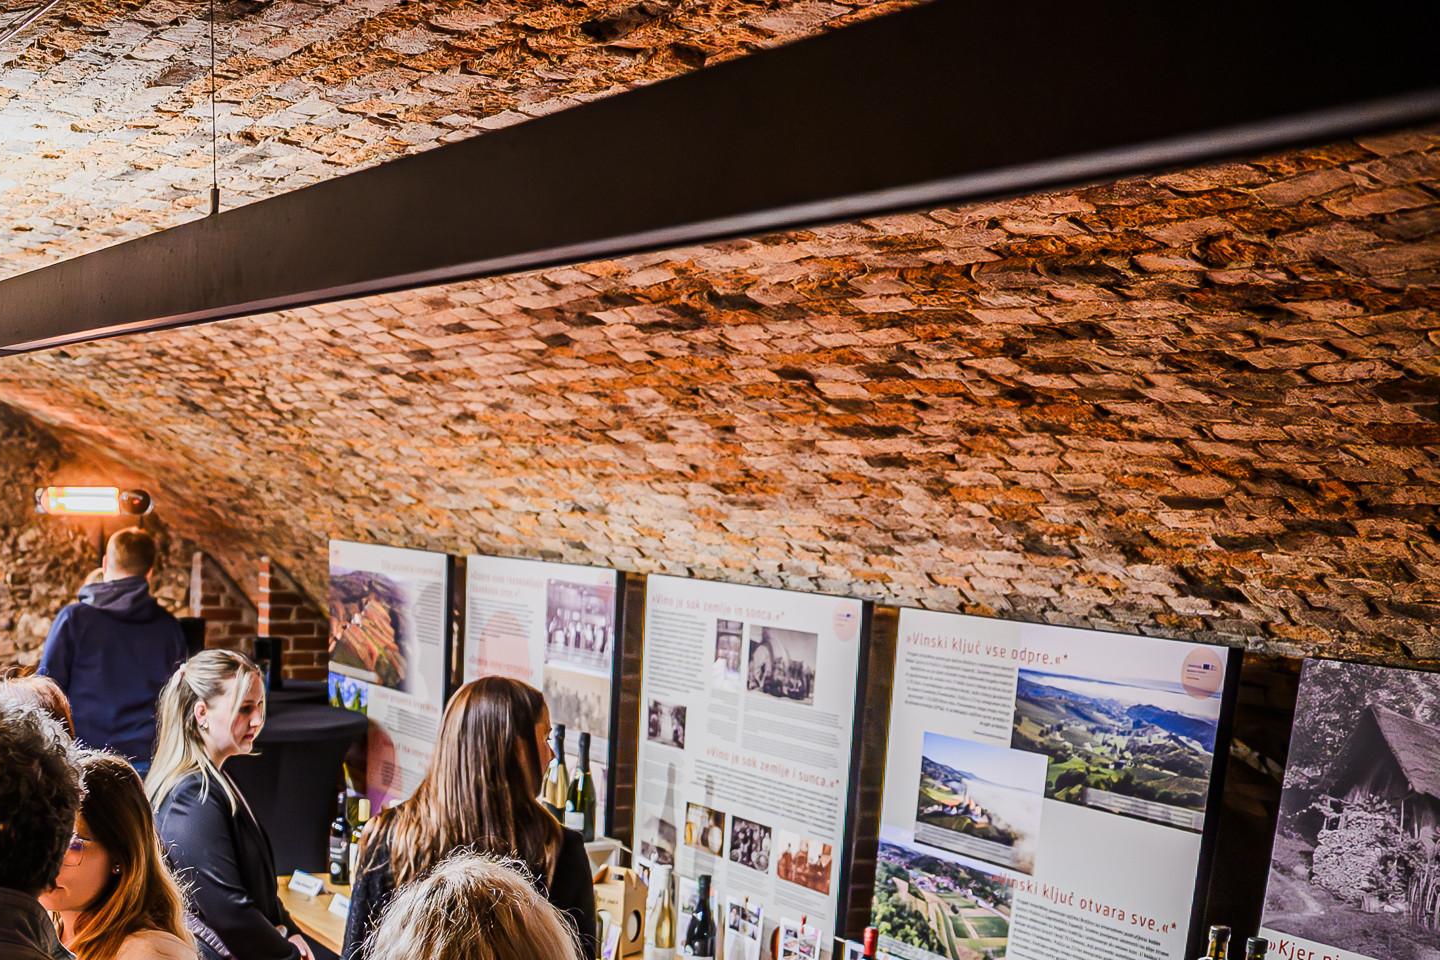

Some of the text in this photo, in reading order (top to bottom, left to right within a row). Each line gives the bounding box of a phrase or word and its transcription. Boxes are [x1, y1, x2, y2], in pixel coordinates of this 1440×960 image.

[952, 635, 981, 656] ključ
[985, 644, 1007, 660] vse
[1043, 884, 1075, 907] ključ
[1080, 897, 1126, 922] otvara
